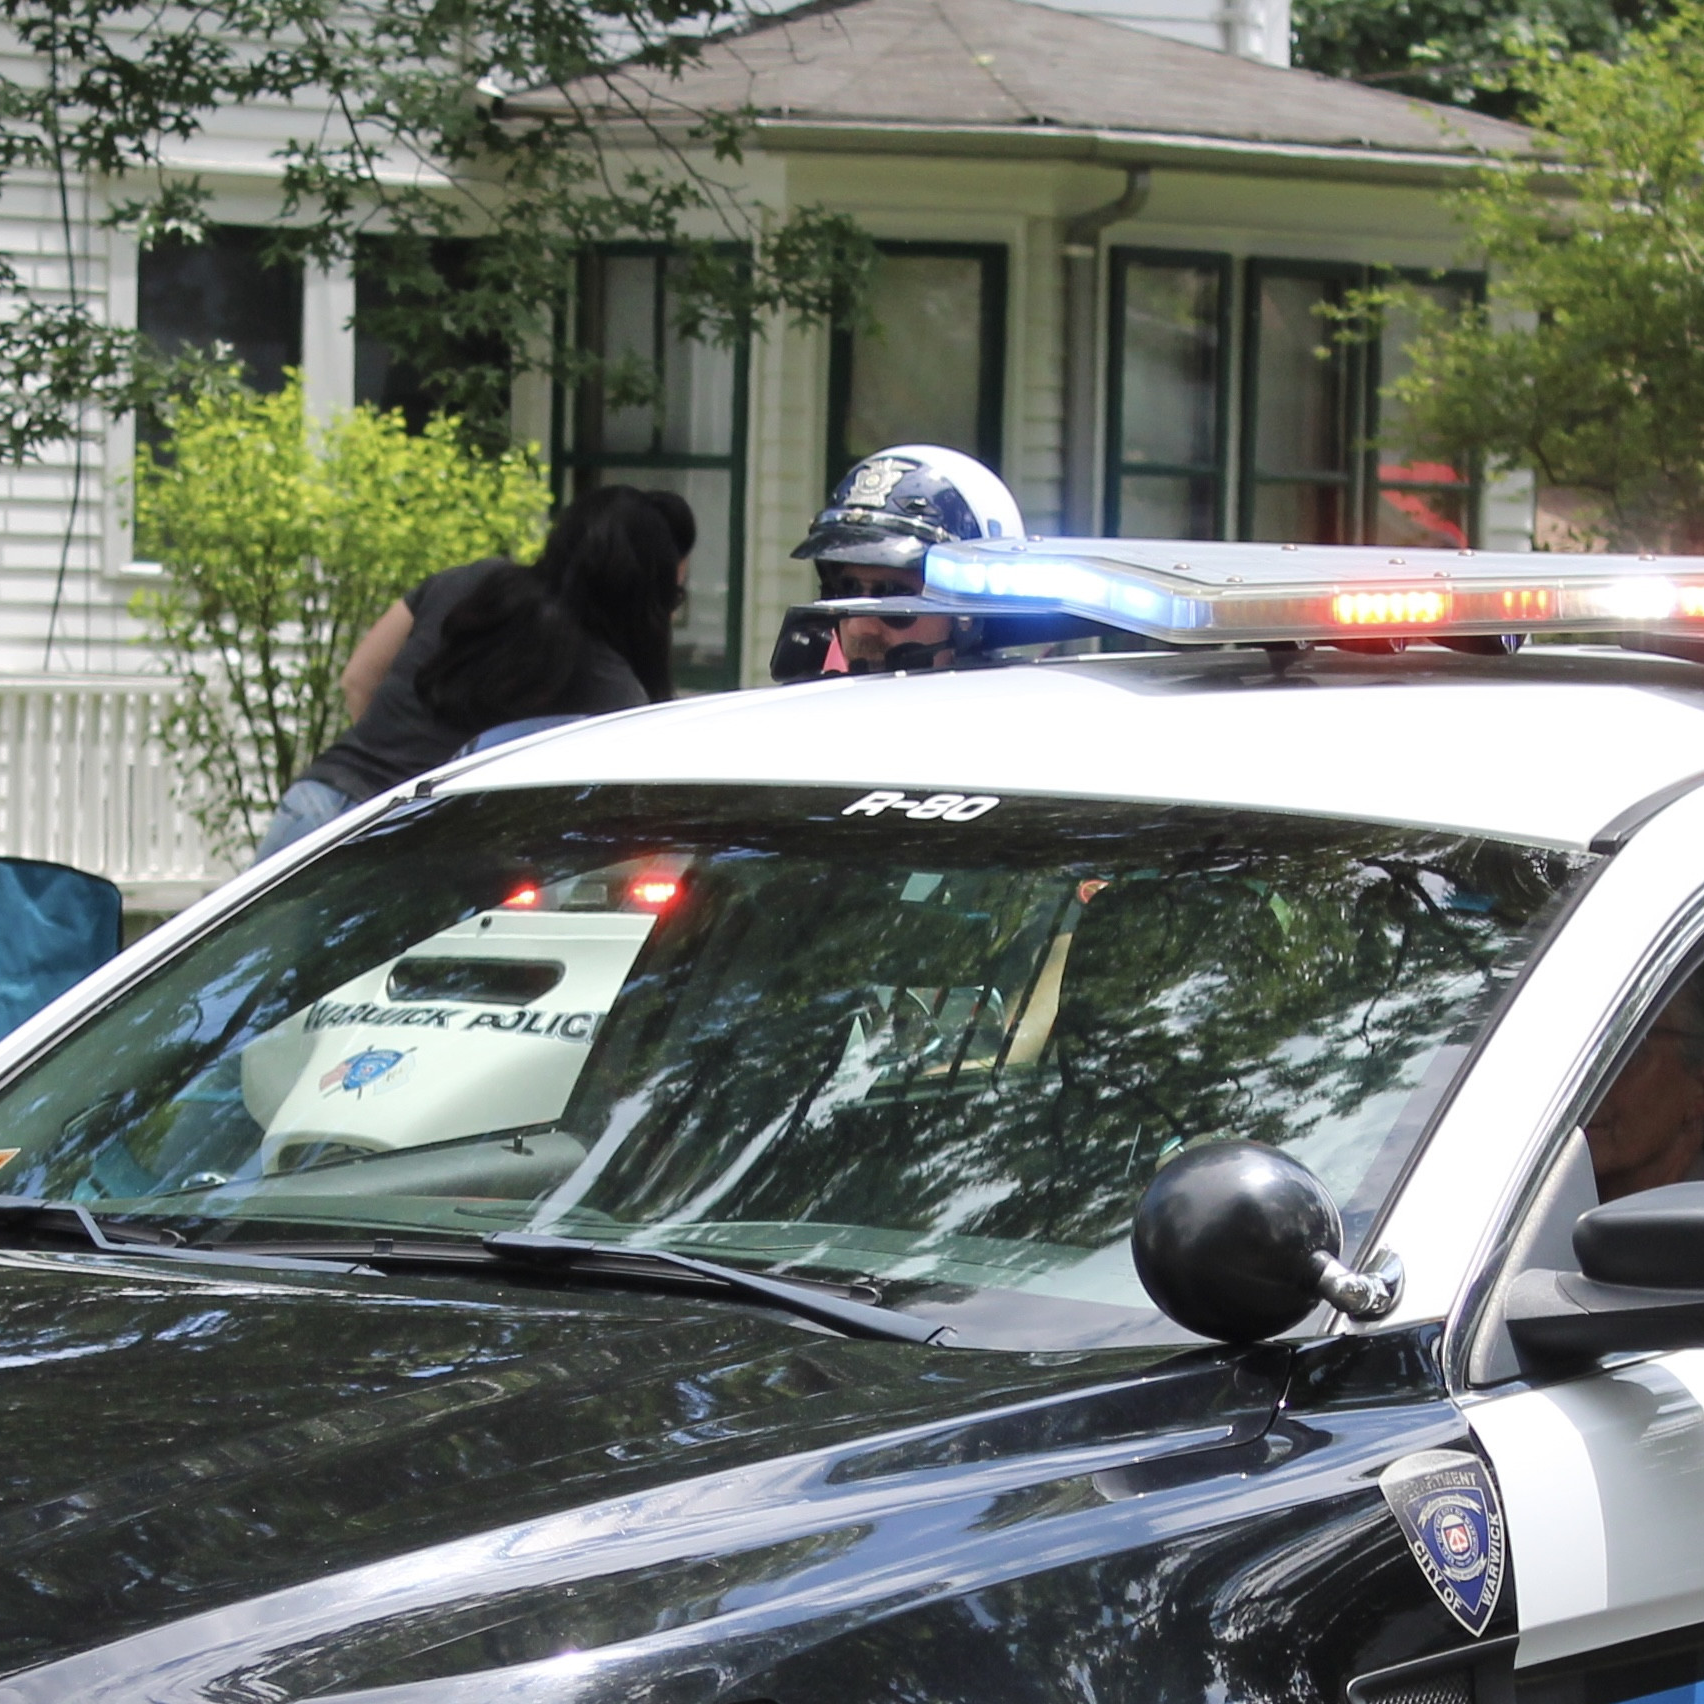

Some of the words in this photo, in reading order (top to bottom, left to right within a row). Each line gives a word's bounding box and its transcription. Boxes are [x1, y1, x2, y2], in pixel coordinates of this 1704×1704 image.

[841, 791, 1000, 822] R-80
[303, 1000, 462, 1034] WARWICK
[1413, 1539, 1442, 1586] CITY
[1443, 1587, 1462, 1611] OF
[1480, 1512, 1500, 1608] WARWICK
